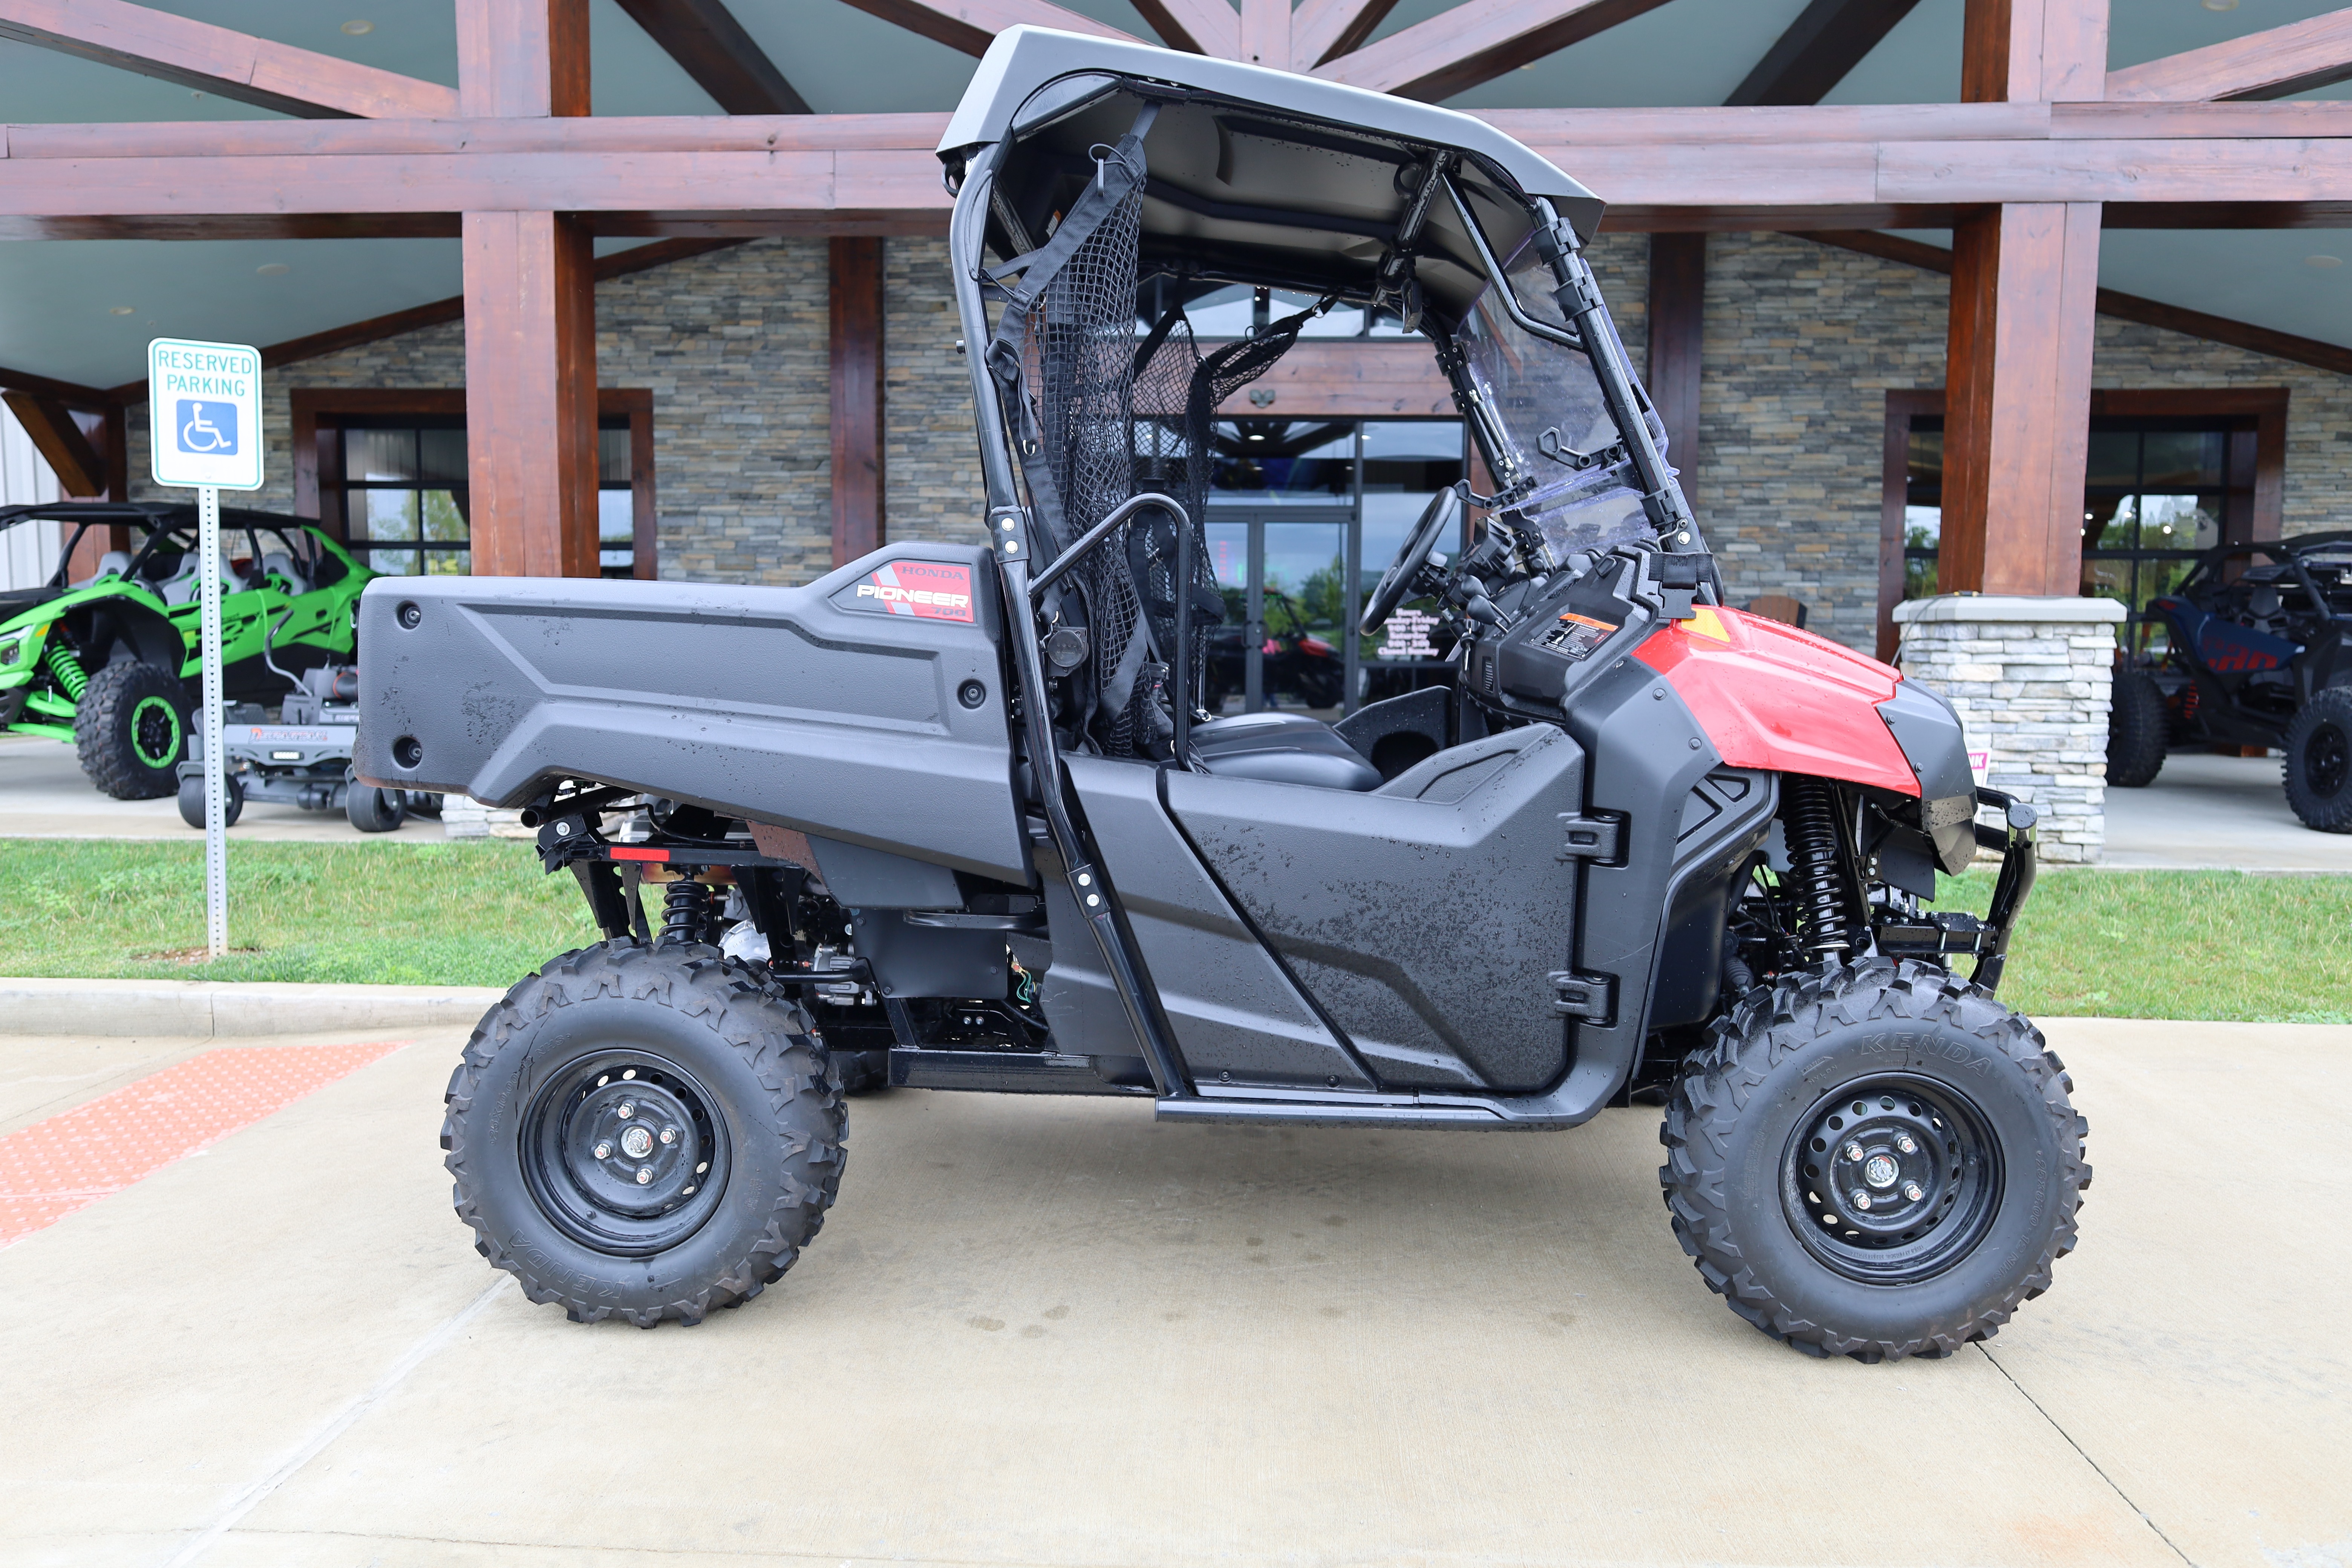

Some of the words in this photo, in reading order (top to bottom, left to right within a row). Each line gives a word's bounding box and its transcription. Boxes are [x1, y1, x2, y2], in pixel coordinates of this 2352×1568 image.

[159, 350, 252, 374] RESERVED
[167, 374, 245, 397] PARKING
[902, 566, 965, 580] HONDA
[856, 584, 969, 608] PIONEER
[932, 606, 966, 617] 700
[1384, 616, 1440, 626] onday-Friday
[1395, 608, 1423, 616] Hours
[1389, 632, 1428, 640] Saturday
[1377, 646, 1406, 655] Closed
[1407, 646, 1439, 656] Sunday
[534, 1034, 565, 1059] NHS
[1861, 1032, 1992, 1078] KENDA
[1808, 1065, 1838, 1085] NYLON
[509, 1228, 625, 1299] KENDA
[1992, 1251, 2019, 1283] NHS
